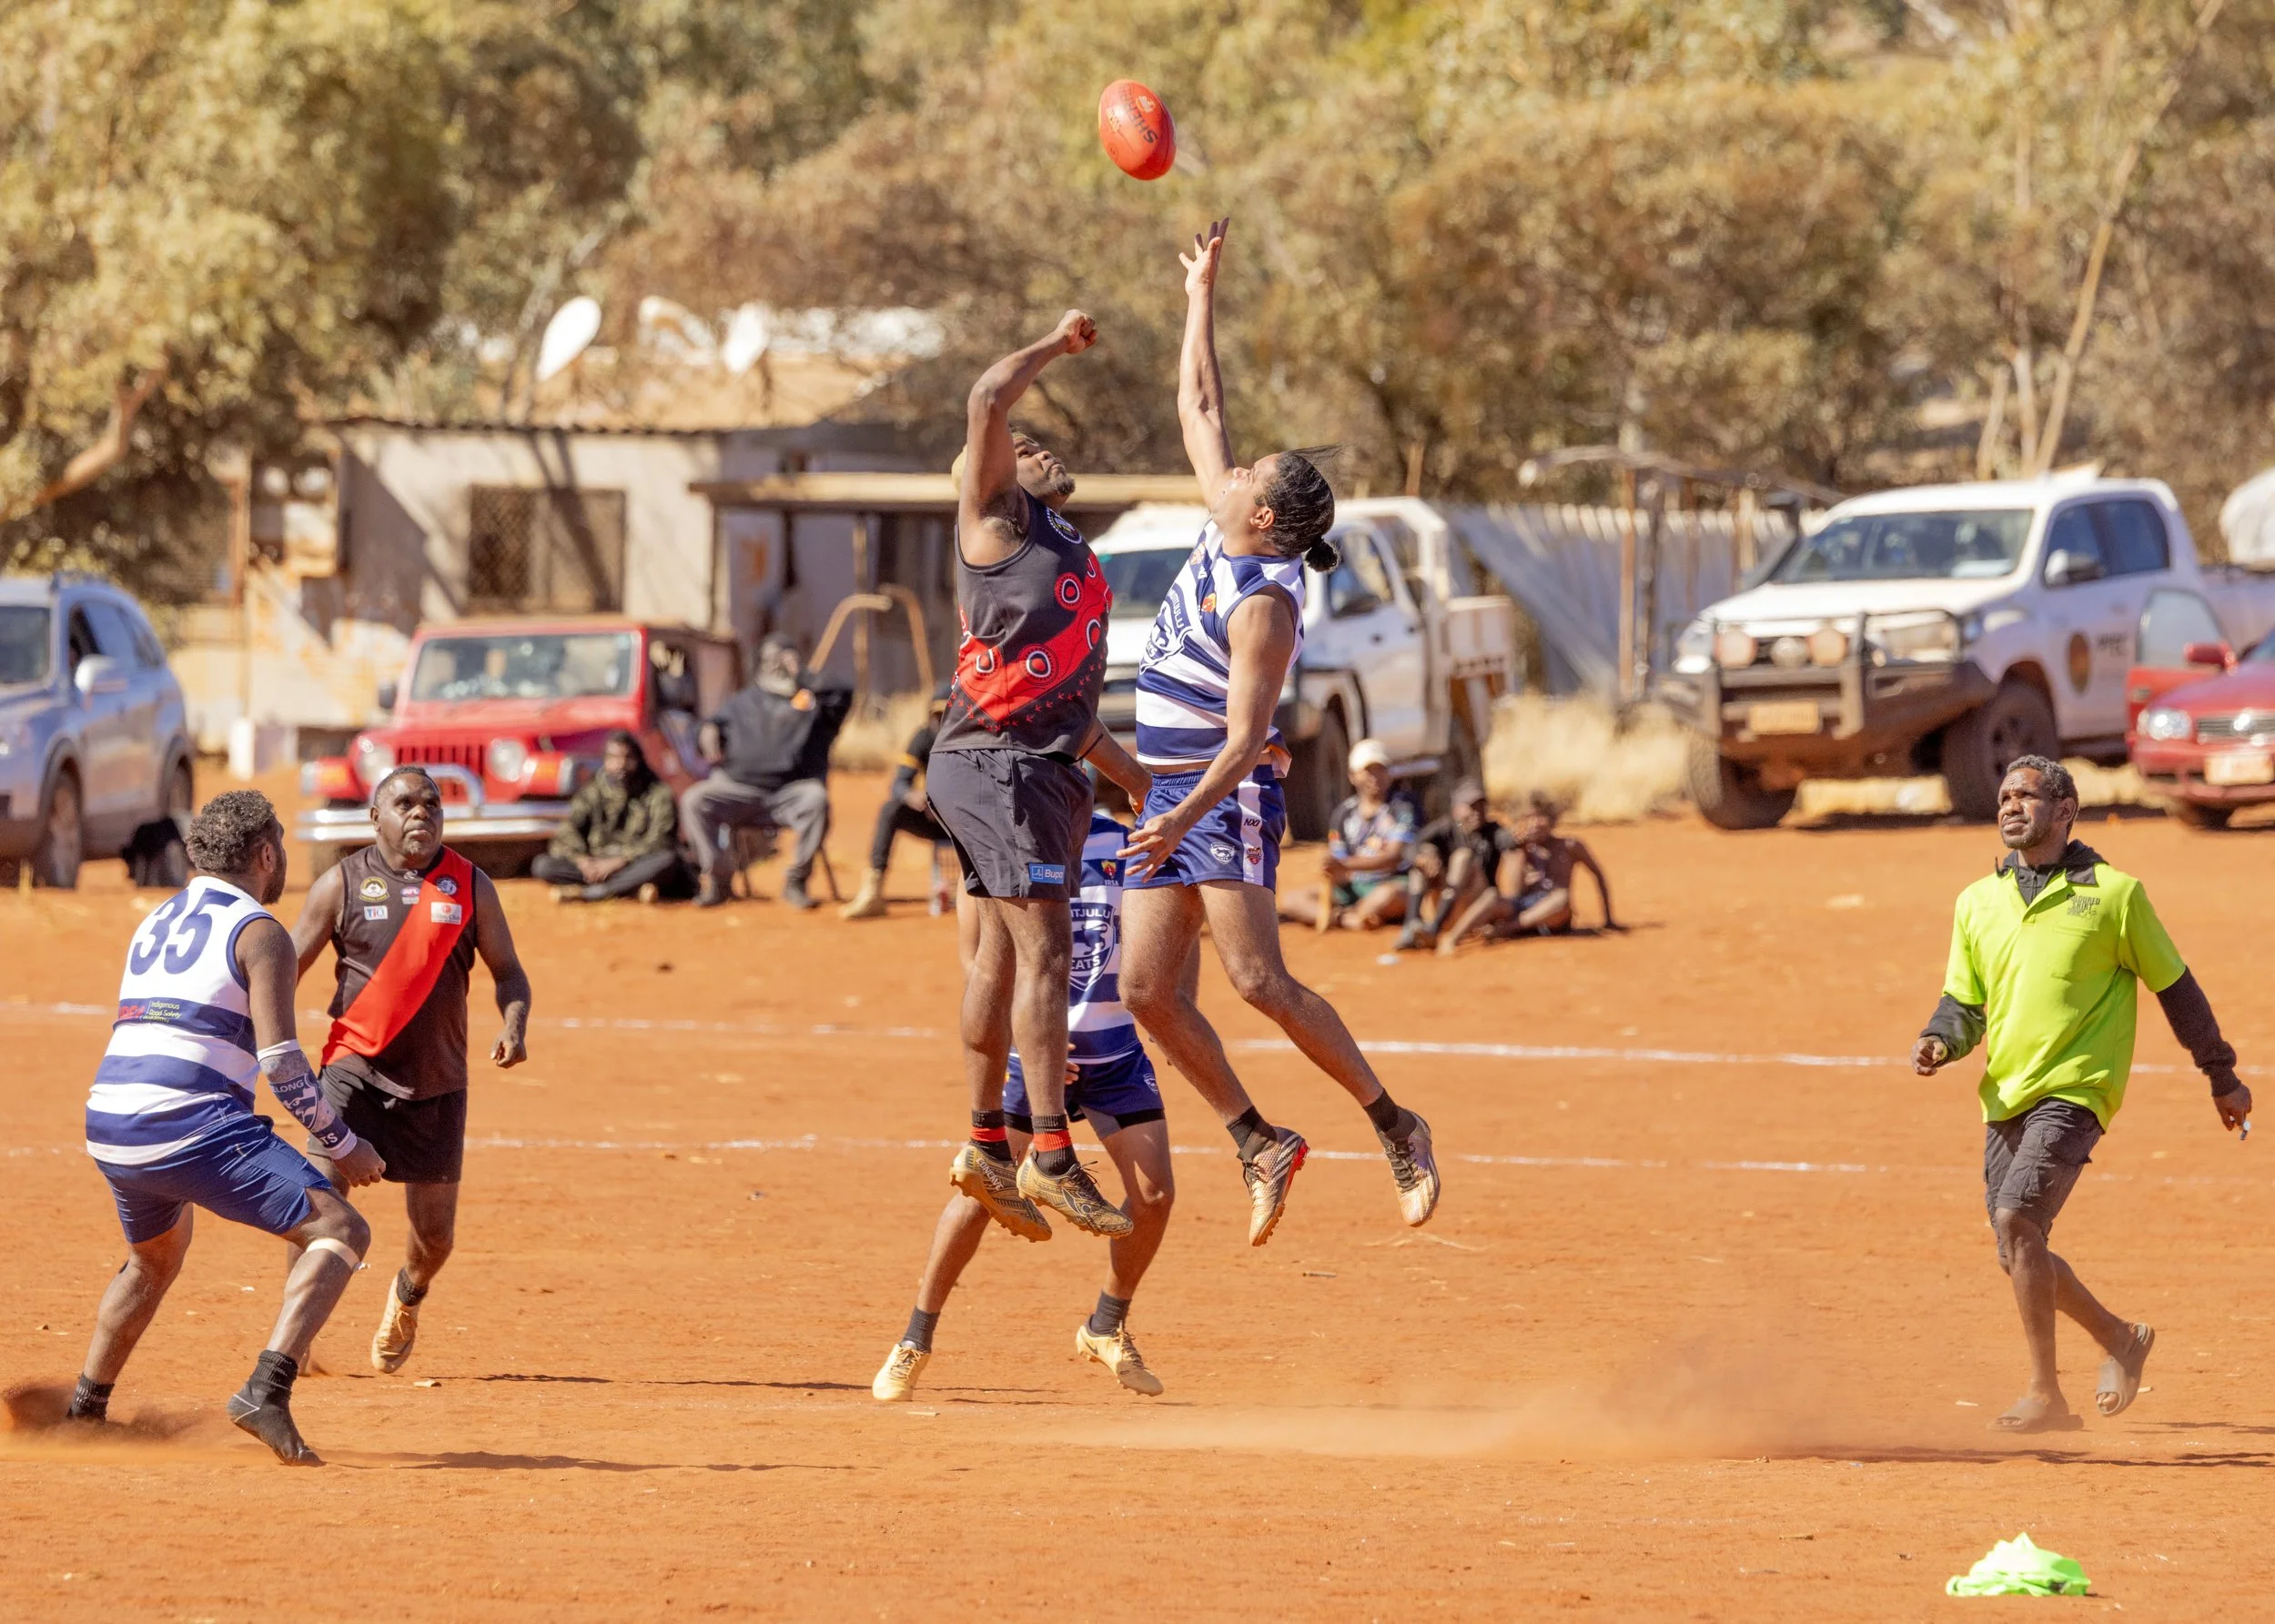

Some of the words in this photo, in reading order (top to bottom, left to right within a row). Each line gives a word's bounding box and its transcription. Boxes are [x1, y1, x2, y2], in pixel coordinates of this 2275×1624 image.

[1045, 869, 1064, 880] Bupa
[130, 887, 240, 976] 35
[151, 1001, 180, 1010] Indigenous
[164, 1010, 182, 1019] Safety
